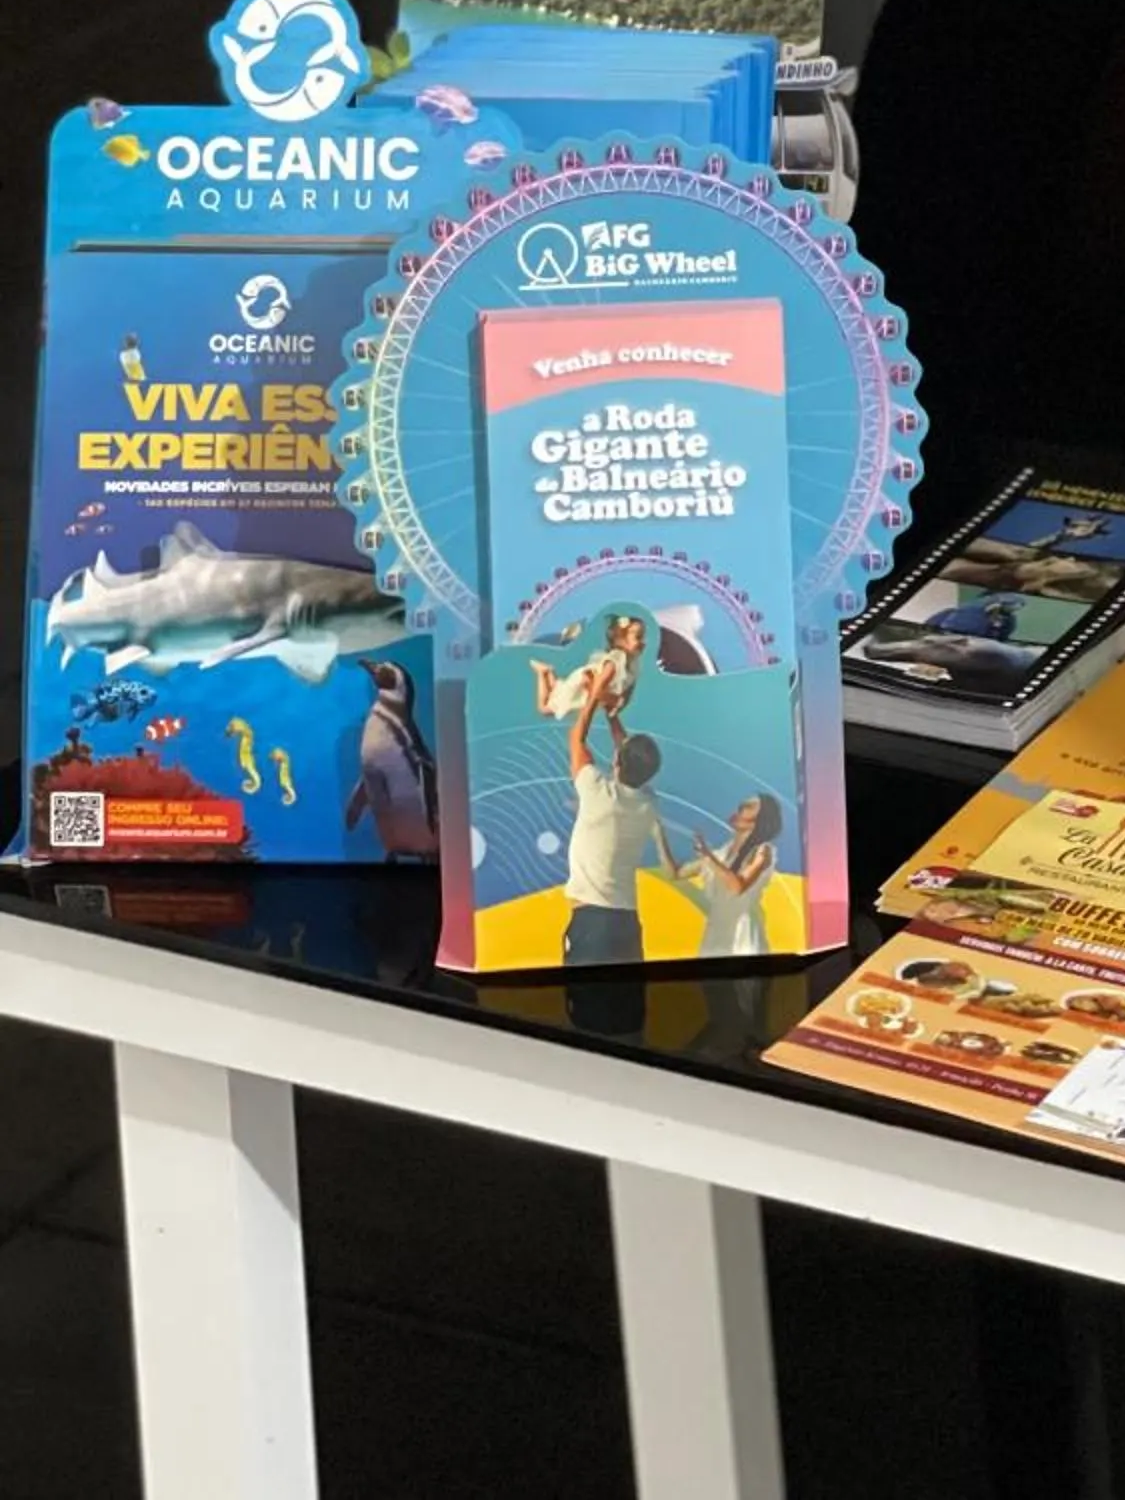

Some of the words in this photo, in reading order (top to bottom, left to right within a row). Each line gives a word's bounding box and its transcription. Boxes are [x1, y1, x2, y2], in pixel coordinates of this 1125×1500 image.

[777, 62, 833, 79] NDINHO
[157, 136, 420, 181] OCEANIC
[166, 187, 410, 212] AQUARIUM
[644, 250, 737, 274] Wheel
[209, 334, 315, 353] OCEANIC
[212, 355, 313, 365] AQUARIUM
[533, 350, 613, 379] Venha
[618, 341, 733, 367] conhecer
[124, 383, 250, 421] VIVA
[582, 414, 602, 432] a
[605, 403, 697, 430] Roda
[79, 423, 341, 470] EXPERIÊN
[530, 428, 710, 469] Gigante
[104, 480, 189, 493] NOVIDADES
[192, 477, 262, 493] INCRÍVEIS
[559, 459, 748, 494] Balneário
[543, 489, 735, 522] Camboriú
[1059, 826, 1096, 846] La
